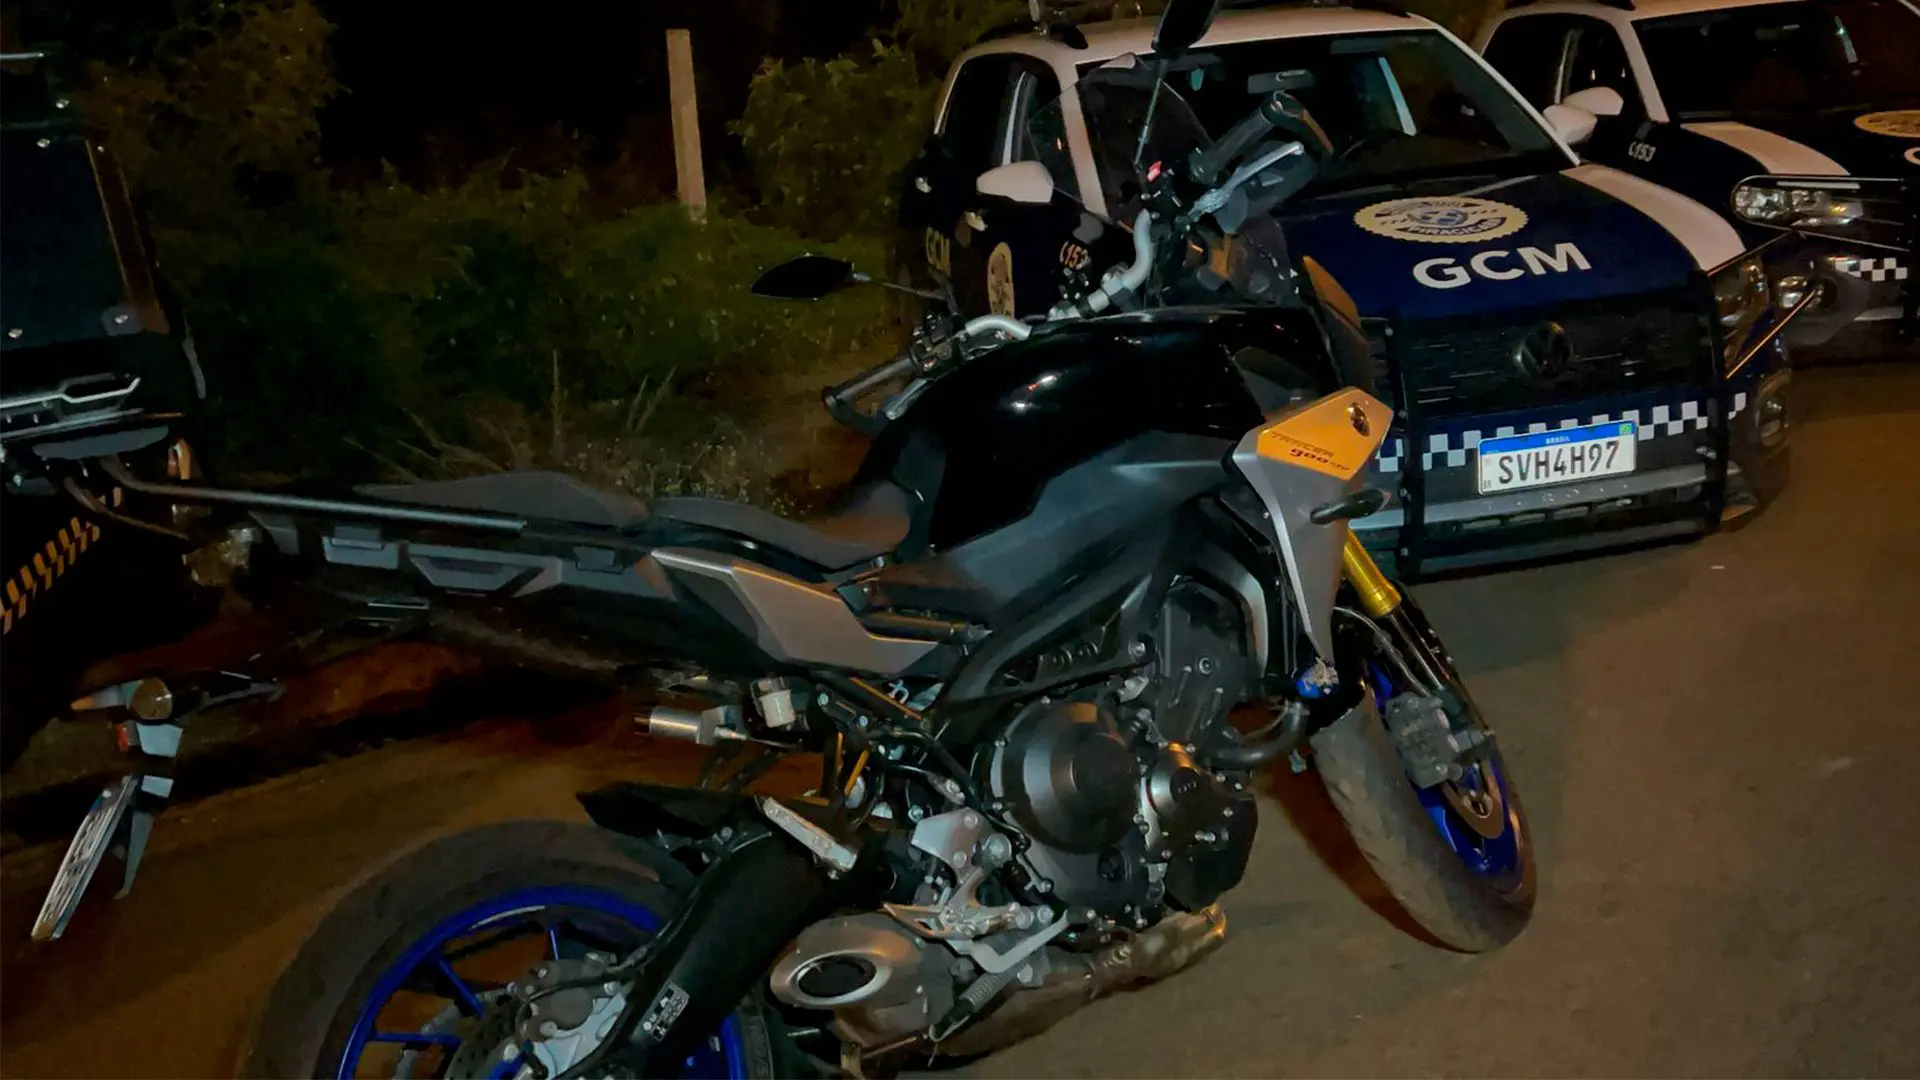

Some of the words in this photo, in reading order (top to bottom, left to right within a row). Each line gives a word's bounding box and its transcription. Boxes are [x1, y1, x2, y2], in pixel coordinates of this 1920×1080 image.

[1413, 242, 1591, 289] GCM
[1289, 448, 1329, 463] 900
[1499, 440, 1620, 484] SVH4H97
